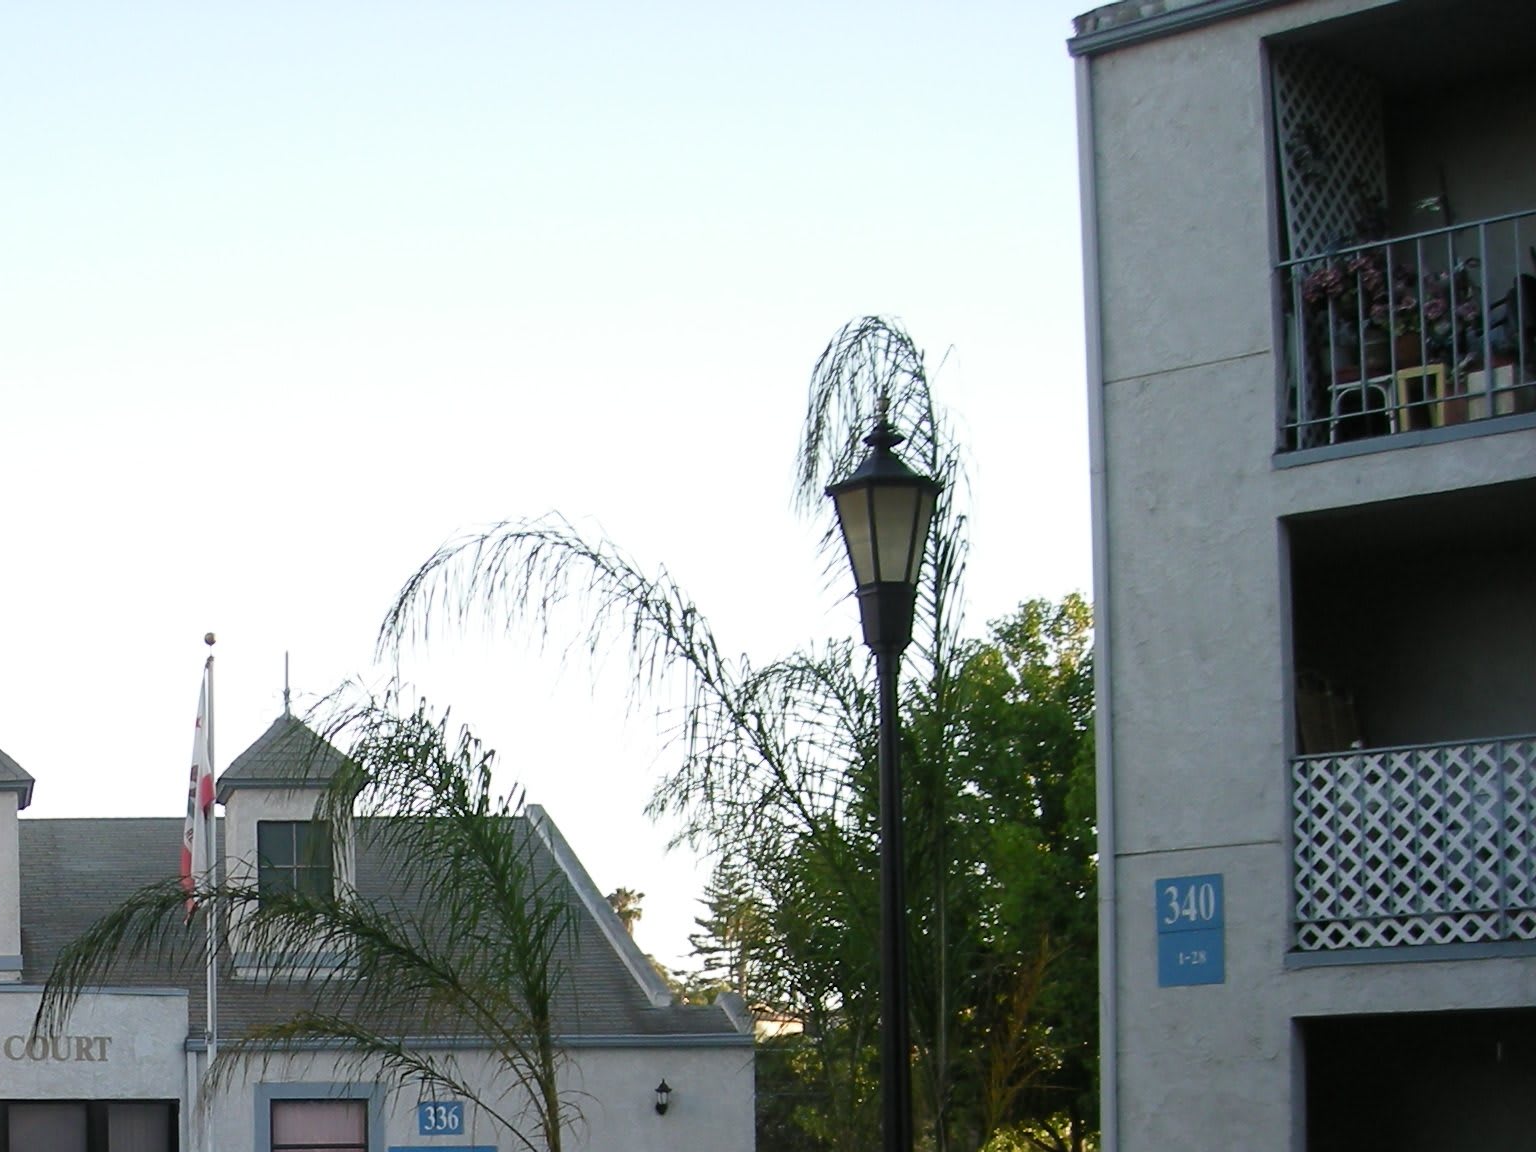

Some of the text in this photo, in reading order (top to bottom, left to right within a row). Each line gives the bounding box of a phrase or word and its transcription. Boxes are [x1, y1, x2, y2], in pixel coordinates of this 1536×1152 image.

[1164, 883, 1215, 925] 340
[3, 1034, 113, 1063] COURT
[424, 1105, 459, 1130] 336
